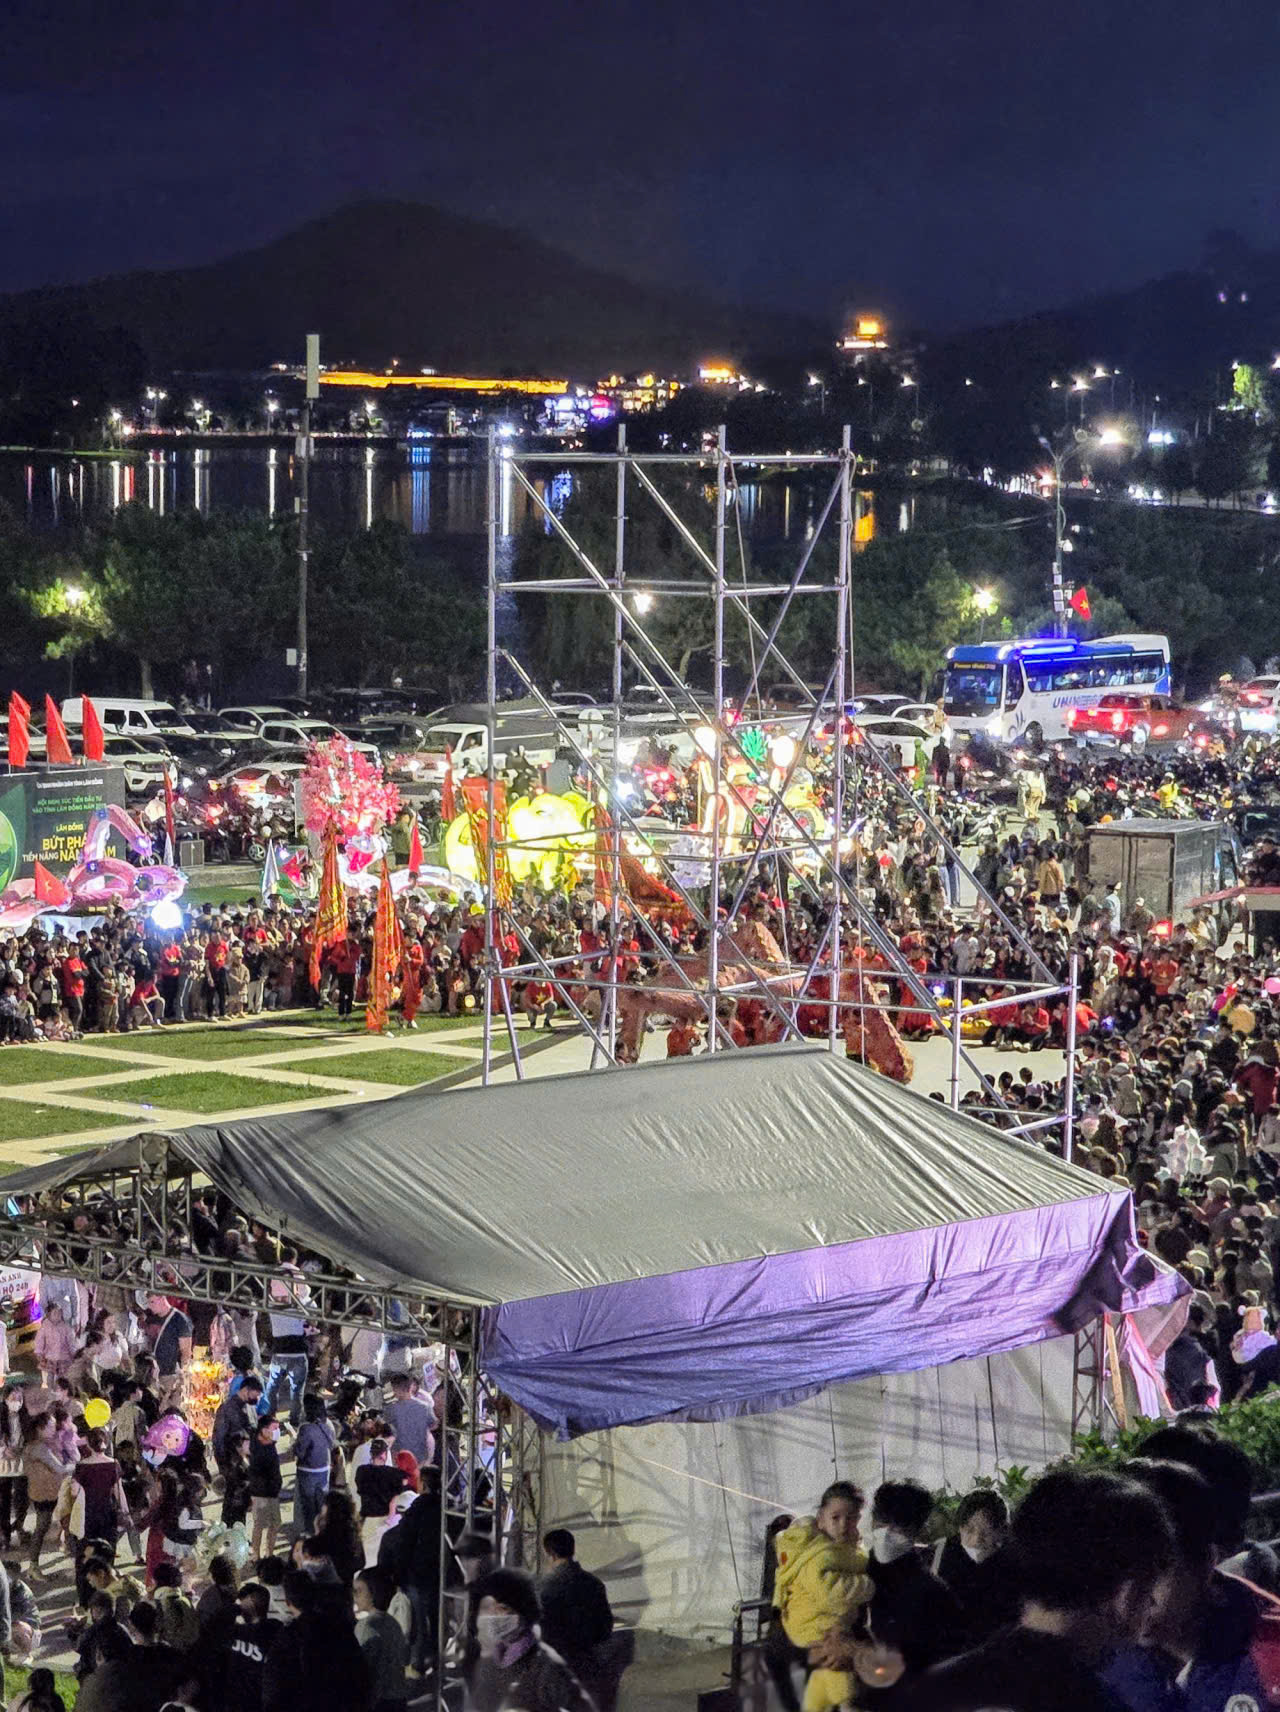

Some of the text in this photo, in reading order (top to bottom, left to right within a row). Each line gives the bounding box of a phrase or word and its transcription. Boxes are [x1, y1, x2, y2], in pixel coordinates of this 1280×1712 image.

[56, 823, 68, 832] LÂM
[42, 834, 66, 850] BỨT
[231, 1639, 268, 1663] JUS
